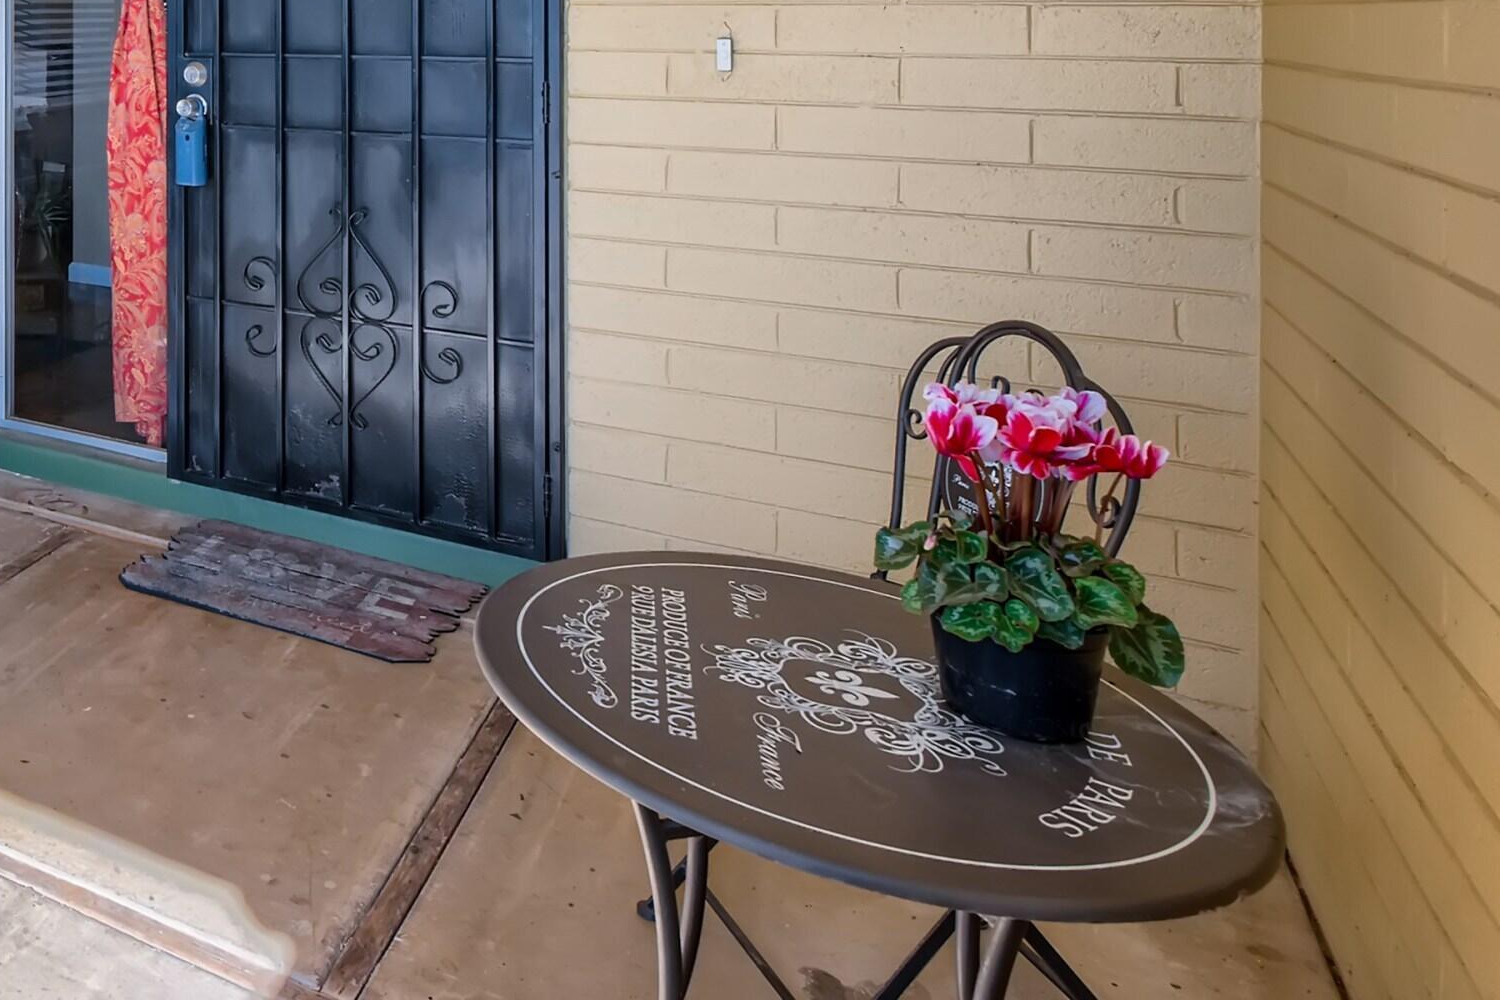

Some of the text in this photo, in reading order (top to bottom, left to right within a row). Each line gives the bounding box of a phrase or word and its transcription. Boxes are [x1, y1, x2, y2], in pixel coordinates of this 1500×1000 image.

[728, 580, 767, 620] Paris
[631, 615, 659, 673] D'ALESIA
[661, 587, 698, 740] PRODUCE OF FRANCE
[630, 674, 660, 724] PARIS
[753, 711, 802, 791] France
[1038, 731, 1133, 838] DE PARIS
